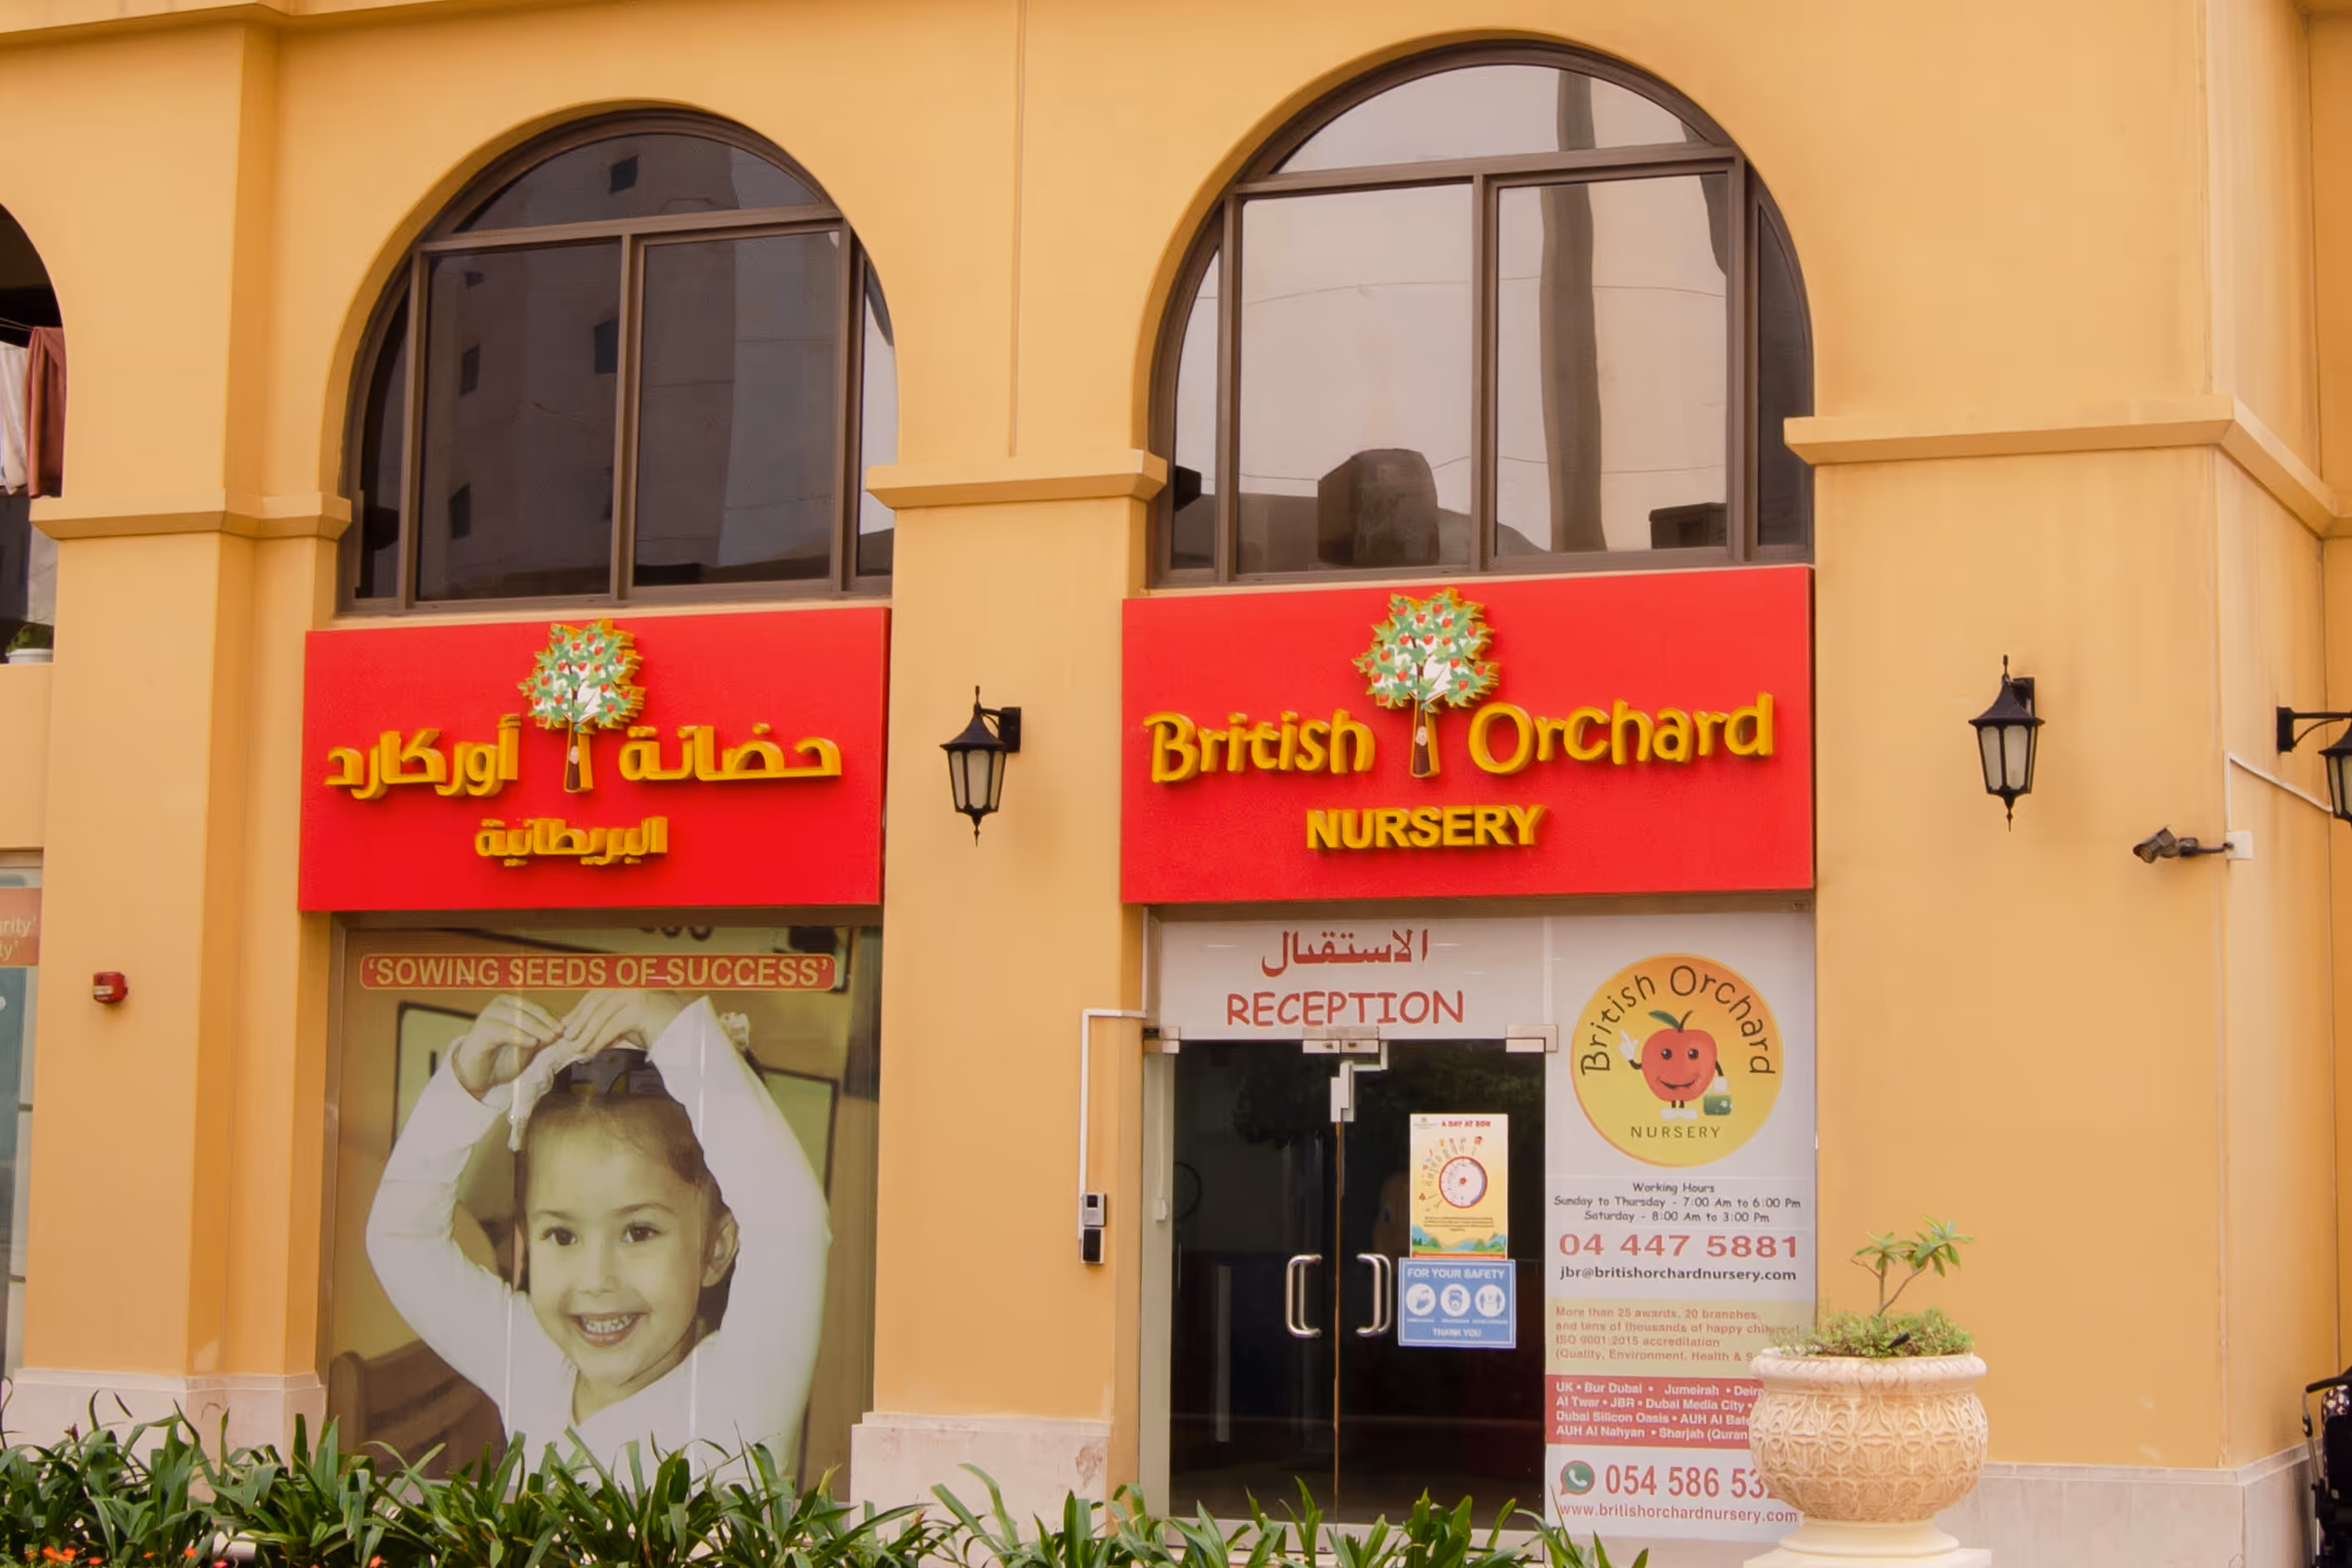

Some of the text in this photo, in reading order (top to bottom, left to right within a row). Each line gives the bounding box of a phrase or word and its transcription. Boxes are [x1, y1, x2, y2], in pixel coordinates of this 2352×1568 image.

[1143, 692, 1775, 783] British Orchard
[323, 713, 842, 800] حضانة أوركارد
[1306, 803, 1548, 850] NURSERY
[475, 816, 669, 867] البريطانية
[509, 958, 606, 986] SEEDS
[615, 957, 657, 986] OF
[1226, 990, 1463, 1027] RECEPTION
[1580, 965, 1776, 1076] British Orchard
[1630, 1126, 1721, 1139] NURSERY
[1633, 1181, 1715, 1195] Working Hours
[1554, 1195, 1593, 1209] Sunday
[1598, 1196, 1609, 1206] to
[1614, 1195, 1666, 1209] Thursday
[1682, 1196, 1709, 1208] 7:00
[1714, 1197, 1732, 1208] Am
[1737, 1198, 1749, 1208] to
[1752, 1197, 1780, 1209] 6:00
[1785, 1198, 1801, 1209] Pm
[1584, 1210, 1635, 1224] Saturday
[1652, 1210, 1678, 1222] 8:00
[1683, 1212, 1701, 1222] Am
[1707, 1212, 1717, 1222] to
[1722, 1212, 1750, 1223] 3:00
[1754, 1212, 1770, 1223] Pm
[1559, 1233, 1798, 1259] 04 447 5881
[1407, 1268, 1505, 1280] FOR YOUR SAFETY
[1559, 1266, 1797, 1283] jbr@britishorchardnursery.com
[1556, 1306, 1585, 1317] More
[1589, 1307, 1614, 1317] than
[1685, 1308, 1698, 1319] 20
[1556, 1322, 1577, 1332] and
[1609, 1322, 1621, 1332] of
[1625, 1322, 1687, 1333] thousands
[1691, 1323, 1702, 1333] of
[1706, 1324, 1743, 1336] happy
[1556, 1334, 1577, 1345] ISO
[1643, 1336, 1721, 1347] accreditation
[1691, 1351, 1730, 1361] Health
[1556, 1381, 1574, 1392] UK
[1584, 1382, 1605, 1393] Bur
[1608, 1383, 1643, 1394] Dubai
[1664, 1384, 1720, 1396] Jumeirah
[1556, 1396, 1745, 1414] Al Twar JBR Dubai Media City
[1556, 1410, 1590, 1422] Dubai
[1593, 1411, 1633, 1423] Silicon
[1635, 1412, 1670, 1424] Oasis
[1680, 1414, 1707, 1424] AUH
[1710, 1414, 1722, 1425] Al
[1556, 1424, 1582, 1436] AUH
[1585, 1425, 1598, 1436] Al
[1600, 1426, 1645, 1440] Nahyan
[1658, 1427, 1705, 1441] Sharjah
[1605, 1463, 1778, 1499] 054 586 53
[1559, 1502, 1798, 1526] www.britishorchardnursery.com
